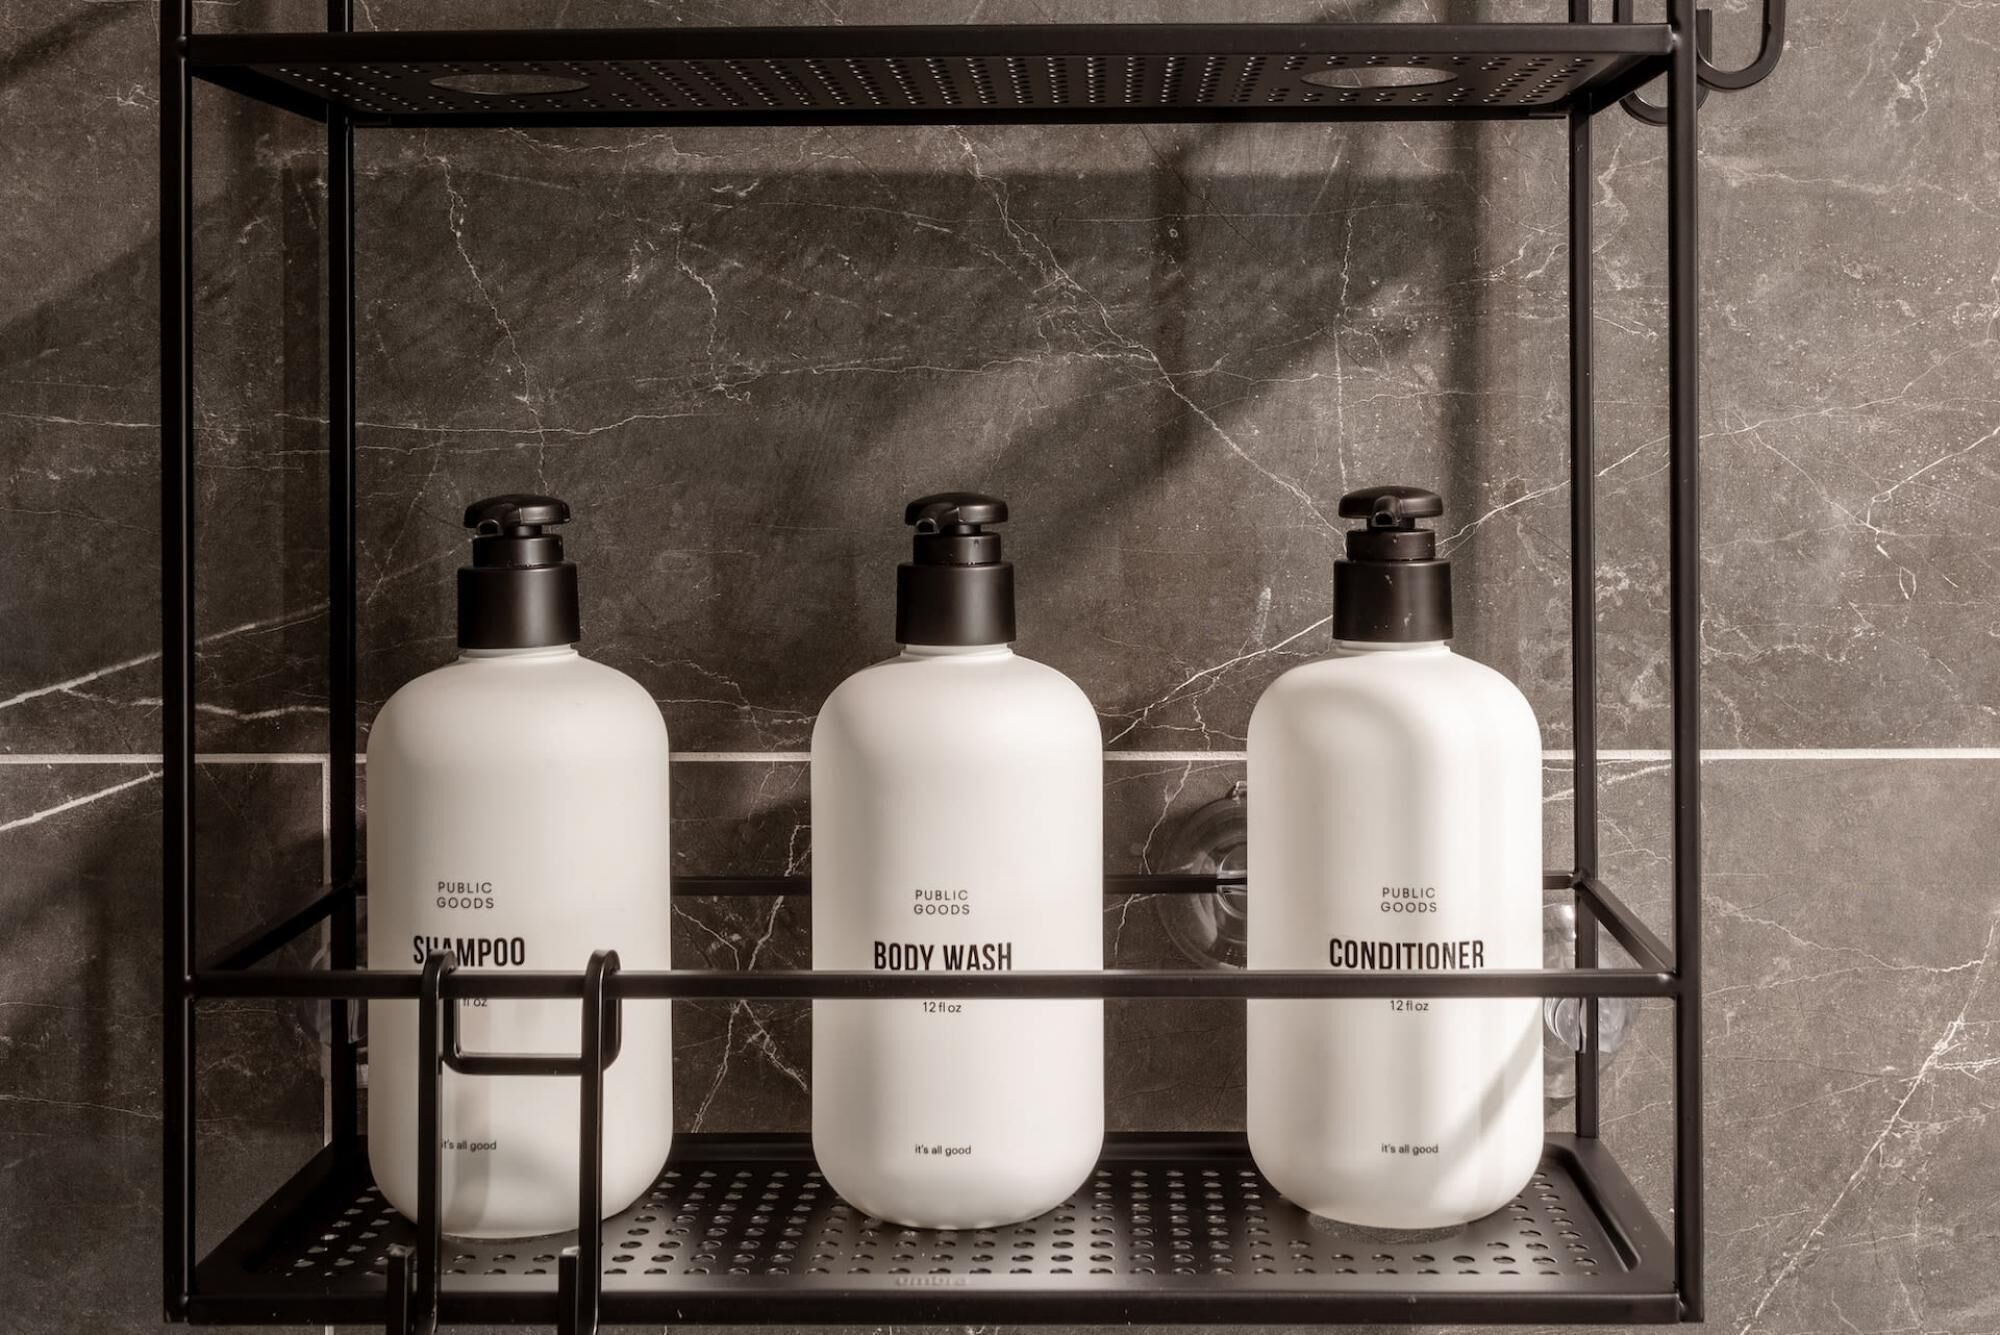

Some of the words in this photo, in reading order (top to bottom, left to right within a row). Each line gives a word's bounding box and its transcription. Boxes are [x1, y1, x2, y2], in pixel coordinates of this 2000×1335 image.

[437, 881, 493, 894] PUBLIC
[1381, 887, 1436, 899] PUBLIC
[914, 889, 969, 901] PUBLIC
[436, 896, 495, 909] GOODS
[1380, 901, 1438, 913] GOODS
[913, 903, 971, 916] GOODS
[874, 941, 935, 970] BODY
[943, 942, 1012, 970] WASH
[1329, 937, 1484, 969] CONDITIONER
[473, 998, 488, 1007] oz
[922, 1001, 937, 1013] 12
[938, 1001, 946, 1013] fl
[947, 1004, 962, 1013] oz
[1390, 1000, 1404, 1011] 12
[1405, 1000, 1413, 1011] fl
[1415, 1002, 1429, 1011] oz
[456, 1140, 467, 1150] all
[470, 1141, 497, 1153] good
[914, 1143, 929, 1155] it's
[931, 1144, 942, 1155] all
[945, 1144, 972, 1156] good
[1381, 1142, 1396, 1154] it's
[1398, 1143, 1410, 1154] all
[1412, 1143, 1439, 1156] good
